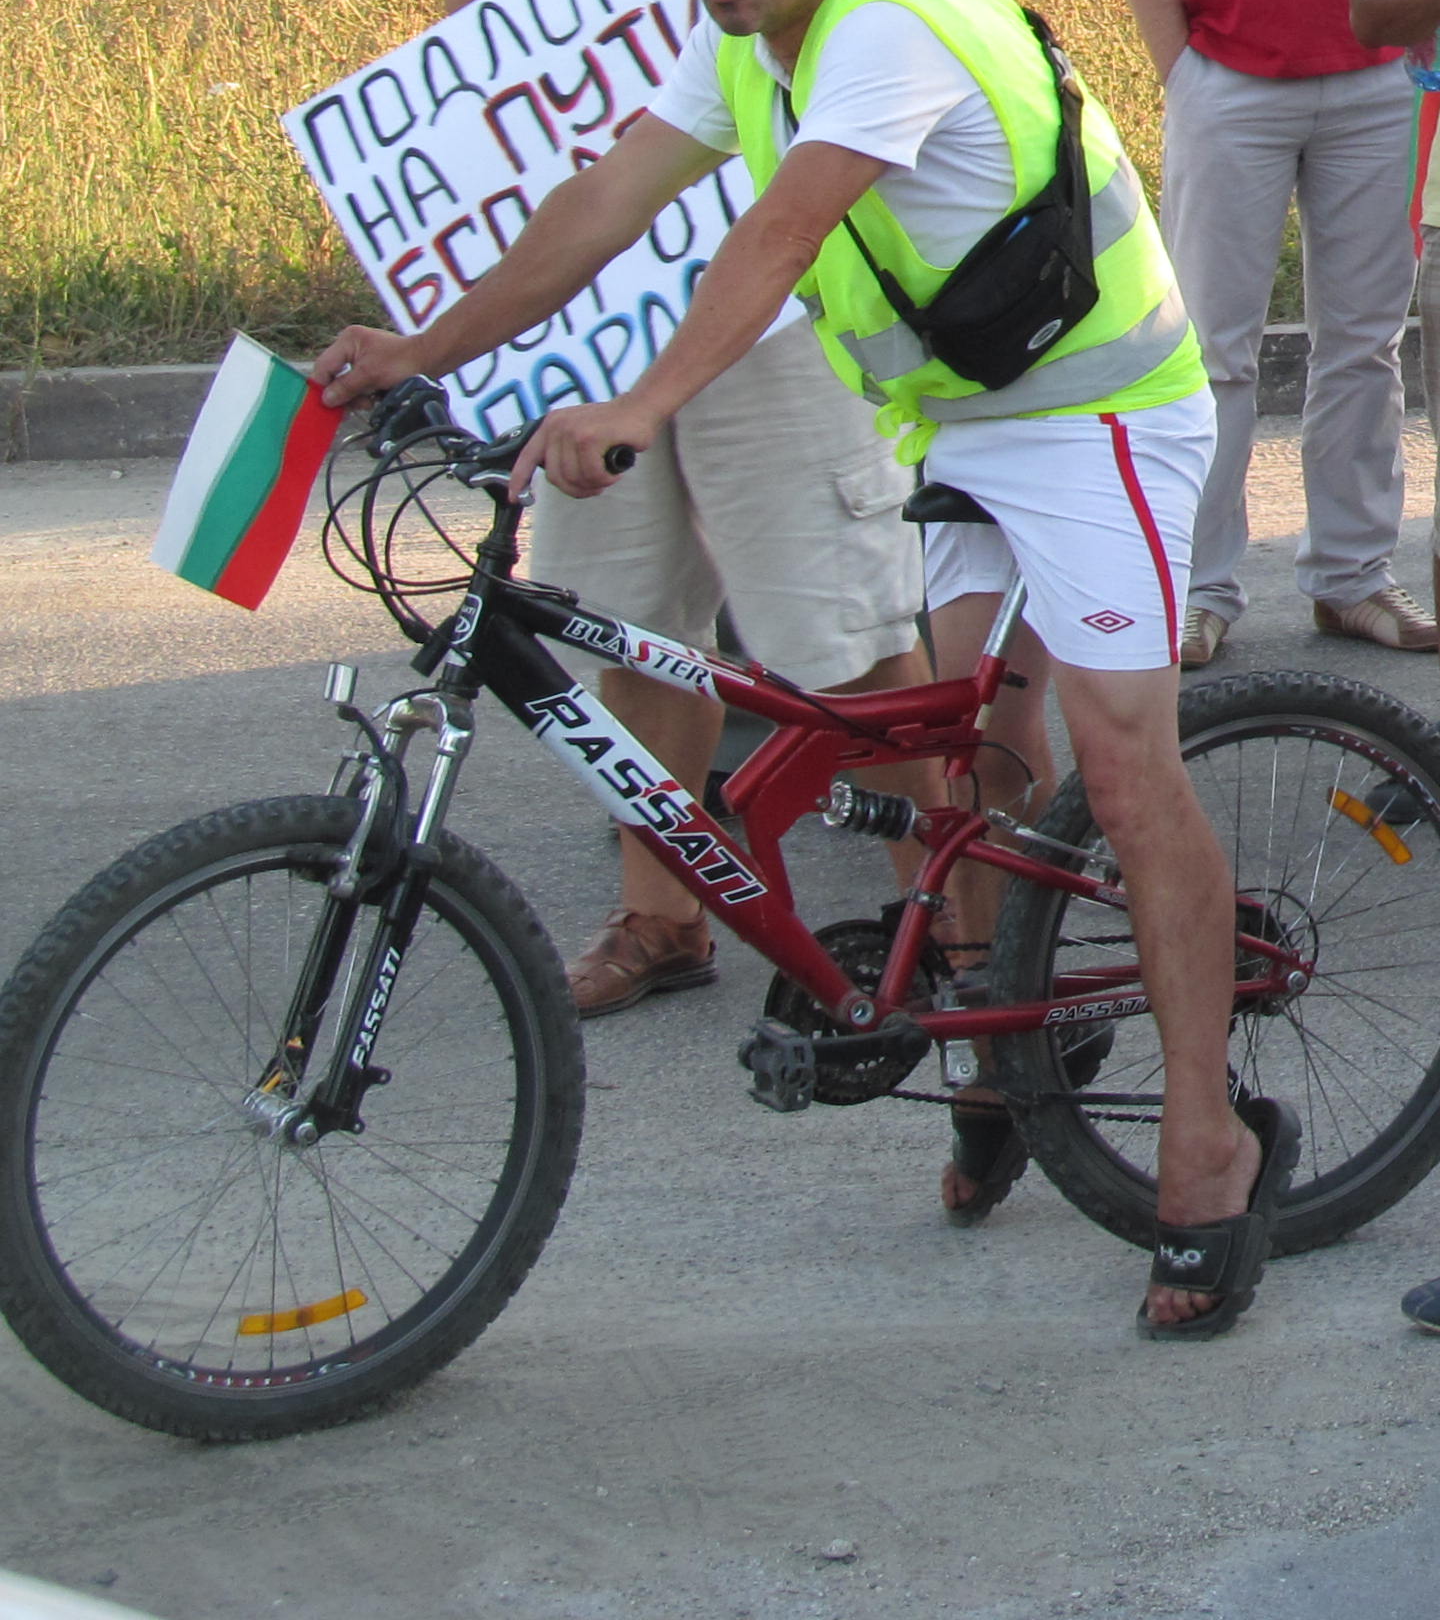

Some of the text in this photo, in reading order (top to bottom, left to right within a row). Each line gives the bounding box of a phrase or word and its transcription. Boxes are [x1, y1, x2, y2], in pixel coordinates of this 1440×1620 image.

[345, 147, 460, 261] НА
[562, 616, 711, 688] BLASTER
[525, 691, 768, 905] PASSATI
[351, 946, 401, 1070] PASSATI
